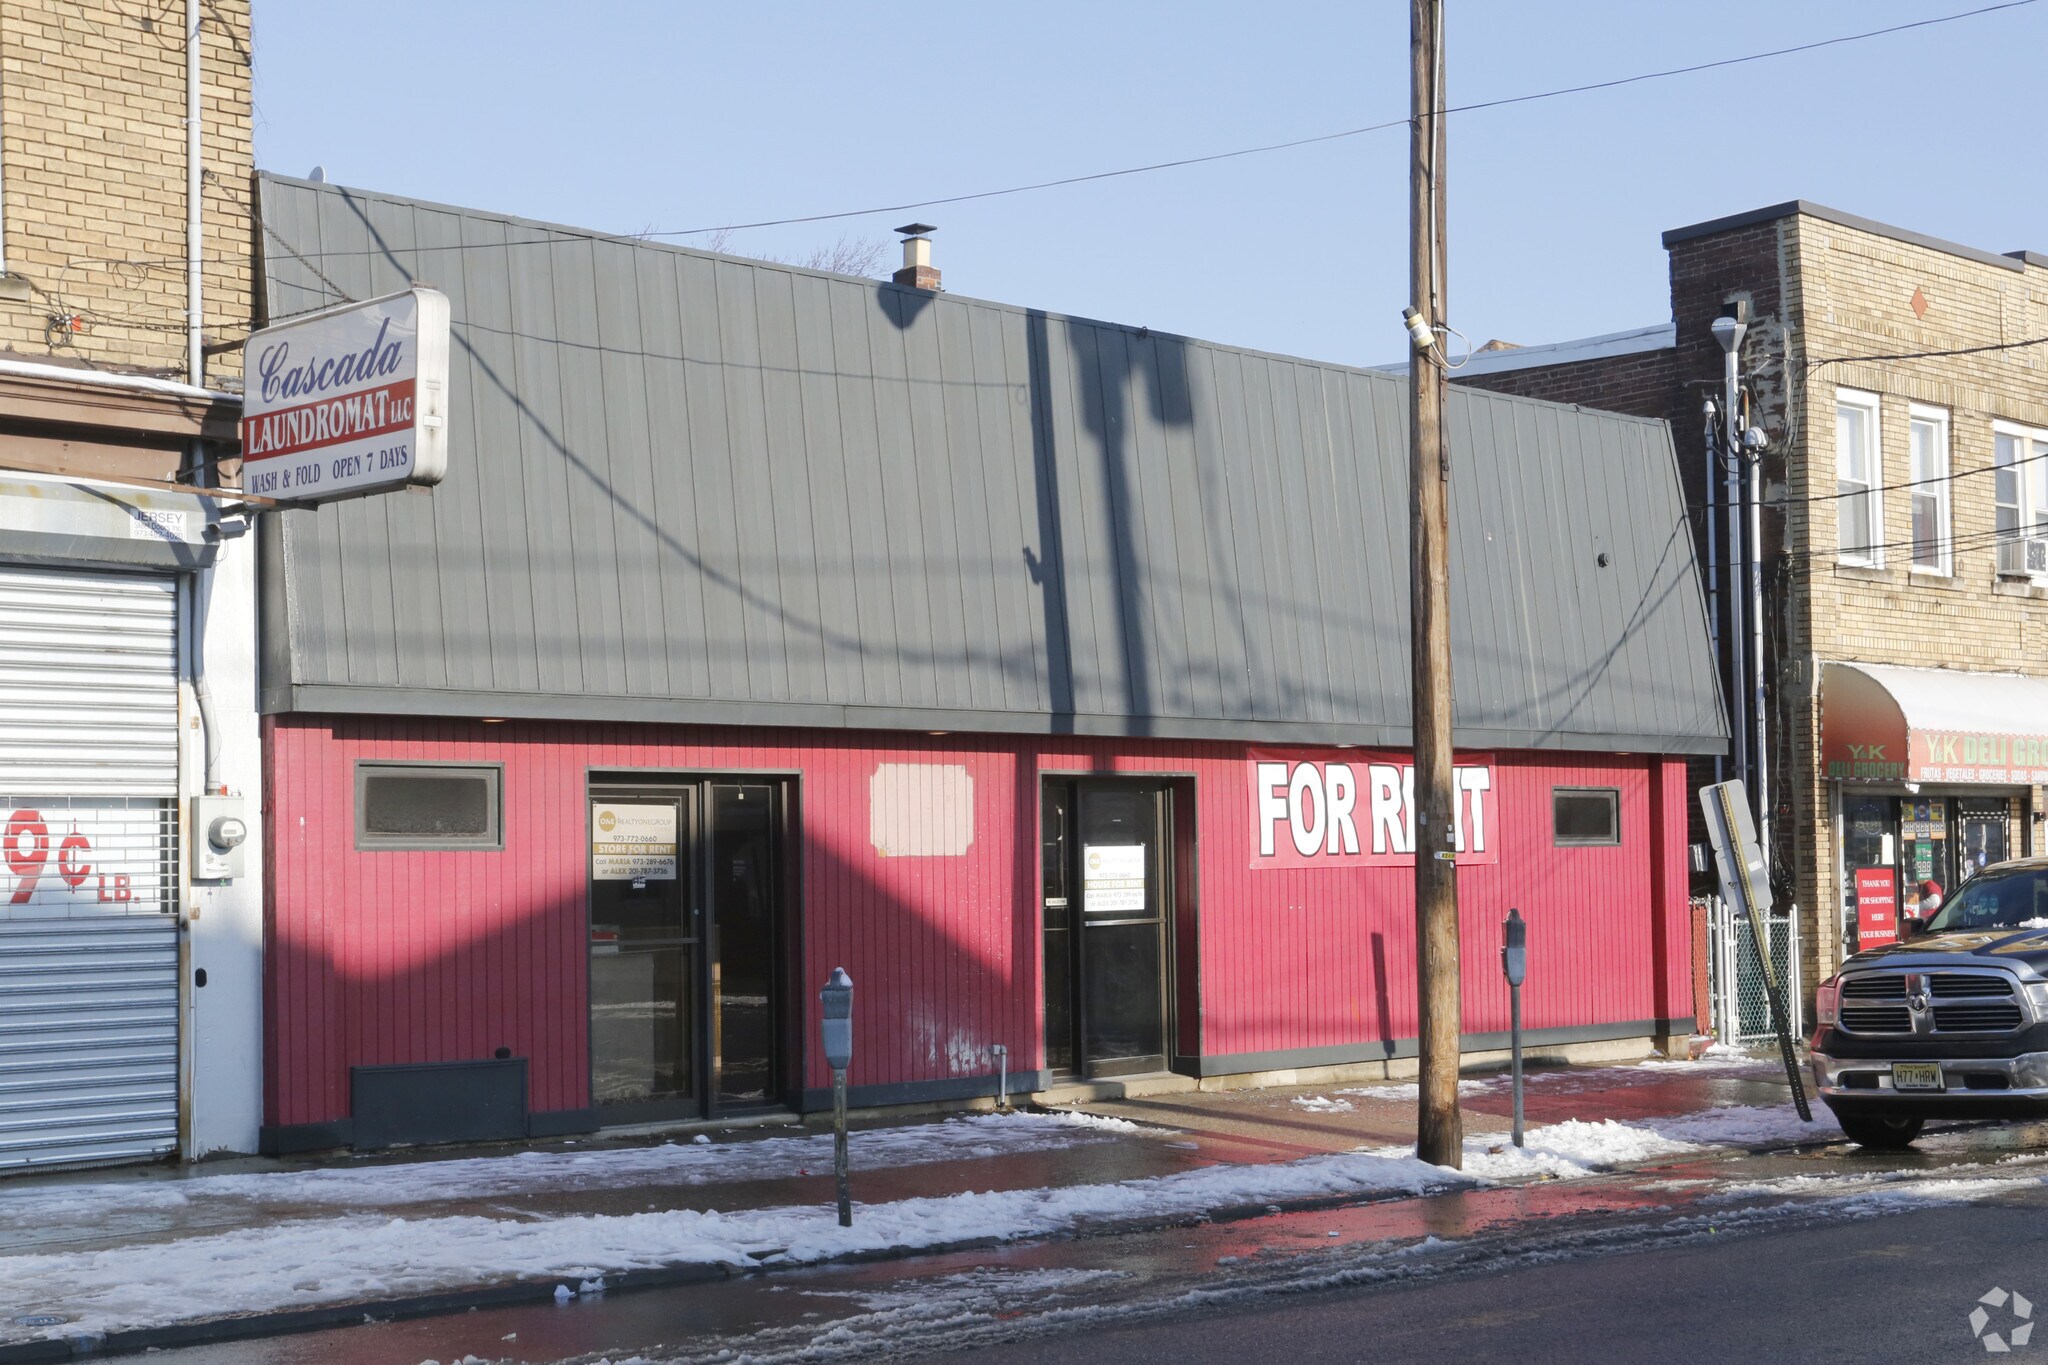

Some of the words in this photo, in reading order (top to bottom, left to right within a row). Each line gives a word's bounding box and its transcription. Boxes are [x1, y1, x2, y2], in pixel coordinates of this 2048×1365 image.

[259, 316, 403, 404] Cascada
[248, 389, 390, 455] LAUNDROMAT
[390, 397, 411, 424] LLC
[251, 471, 278, 494] WASH
[282, 468, 290, 489] &
[295, 463, 321, 486] FOLD
[332, 454, 361, 479] OPEN
[366, 452, 373, 473] 7
[379, 444, 408, 469] DAYS
[133, 511, 183, 524] JERSEY
[1846, 744, 1887, 759] Y&K
[1924, 734, 1959, 765] Y&K
[1963, 736, 2007, 766] DELI
[1828, 761, 1851, 777] DELI
[1854, 761, 1905, 778] GROCERY
[1920, 766, 1942, 779] FRUTAS
[1945, 767, 1975, 780] VEGETALES
[1256, 761, 1361, 857] FOR
[1368, 764, 1491, 855] RT
[613, 835, 657, 843] 973-772-0660
[598, 845, 627, 854] STORE
[629, 845, 647, 854] FOR
[648, 845, 672, 854] RENT
[1087, 881, 1112, 889] HOUSE
[1862, 879, 1880, 888] THANK
[1880, 879, 1890, 888] YOU
[1859, 897, 1870, 905] FOR
[1870, 896, 1894, 904] SHOPPING
[1860, 930, 1875, 939] YOUR
[1875, 929, 1896, 938] BUSINESS
